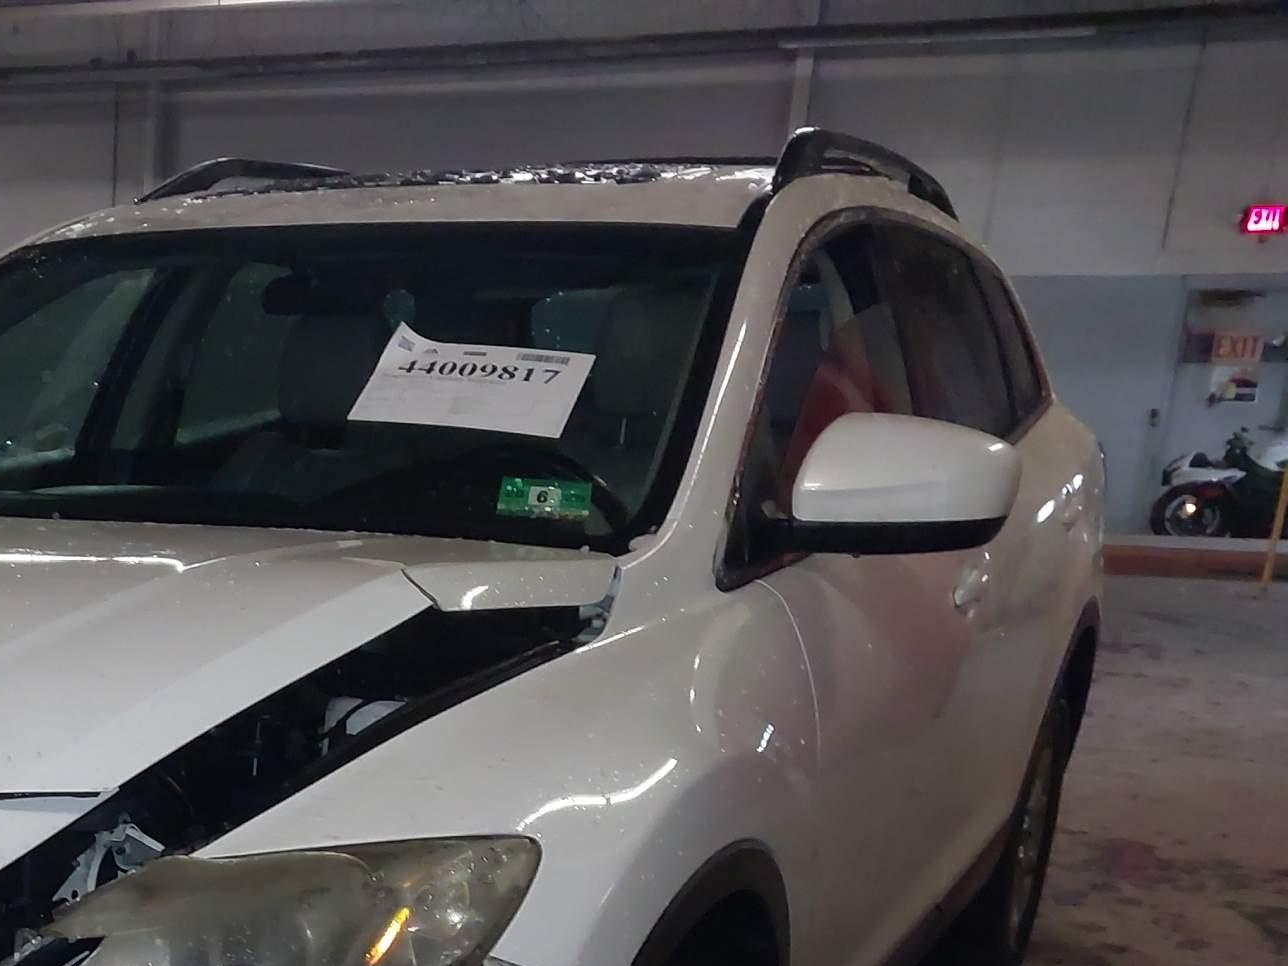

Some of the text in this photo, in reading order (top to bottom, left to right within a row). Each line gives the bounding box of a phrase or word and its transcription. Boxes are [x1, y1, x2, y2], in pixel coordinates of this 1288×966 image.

[1247, 208, 1280, 231] EXIT
[1214, 335, 1259, 358] EXIT
[398, 359, 562, 385] 44009817
[537, 490, 549, 503] 6
